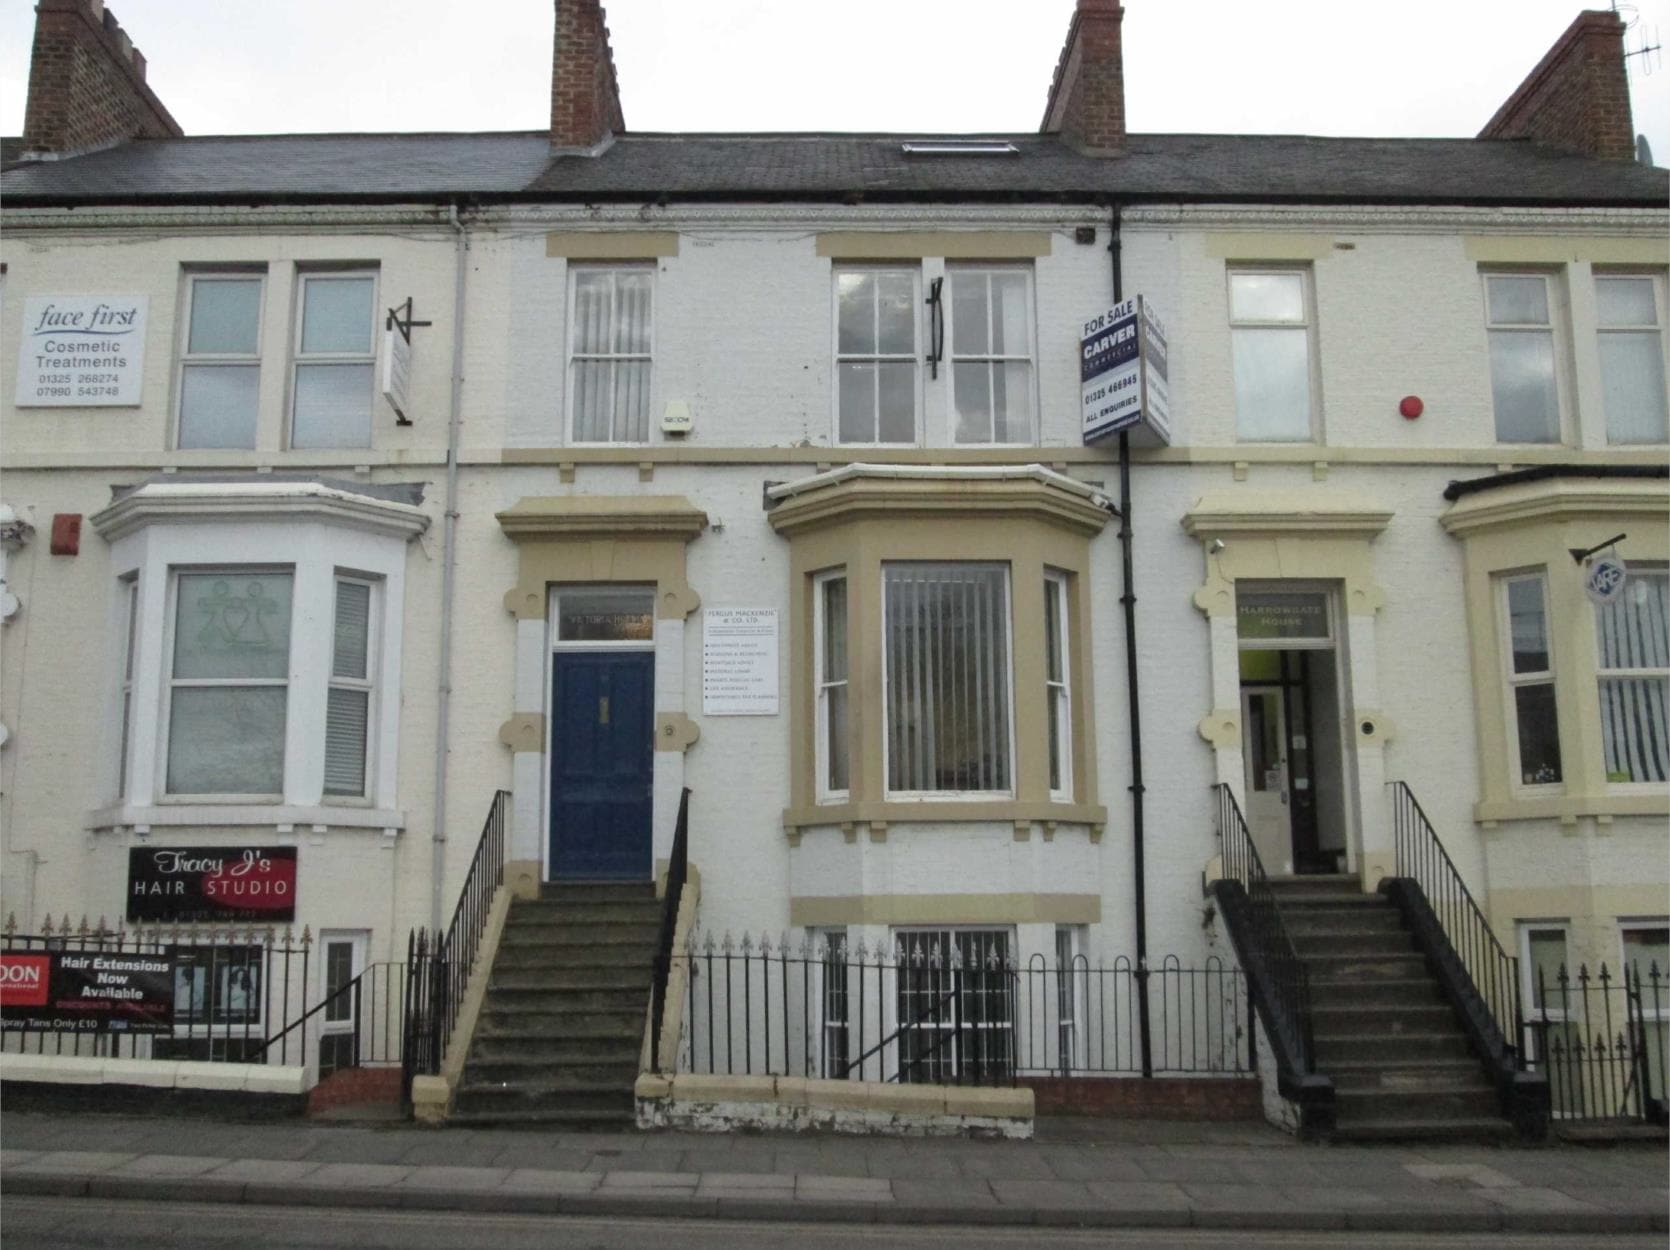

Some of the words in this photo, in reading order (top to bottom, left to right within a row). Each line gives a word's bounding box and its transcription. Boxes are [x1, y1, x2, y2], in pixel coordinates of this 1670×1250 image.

[34, 304, 83, 331] face
[85, 304, 137, 330] first
[1084, 315, 1105, 336] FOR
[1108, 300, 1133, 324] SALE
[44, 340, 121, 353] Cosmetic
[1083, 324, 1136, 360] CARVER
[36, 355, 127, 368] Treatments
[39, 374, 71, 384] 01325
[1085, 388, 1106, 405] 01325
[1085, 411, 1098, 424] ALL
[1100, 396, 1137, 417] ENQUIRIES
[154, 851, 223, 878] Tracy
[230, 850, 271, 876] J's
[134, 881, 184, 895] HAIR
[207, 880, 287, 895] STUDIO
[61, 957, 89, 968] Hair
[93, 958, 169, 972] Extensions
[97, 973, 128, 984] Now
[82, 986, 143, 999] Available
[28, 1018, 50, 1028] Tans
[53, 1018, 77, 1030] Only
[78, 1018, 98, 1028] £10
